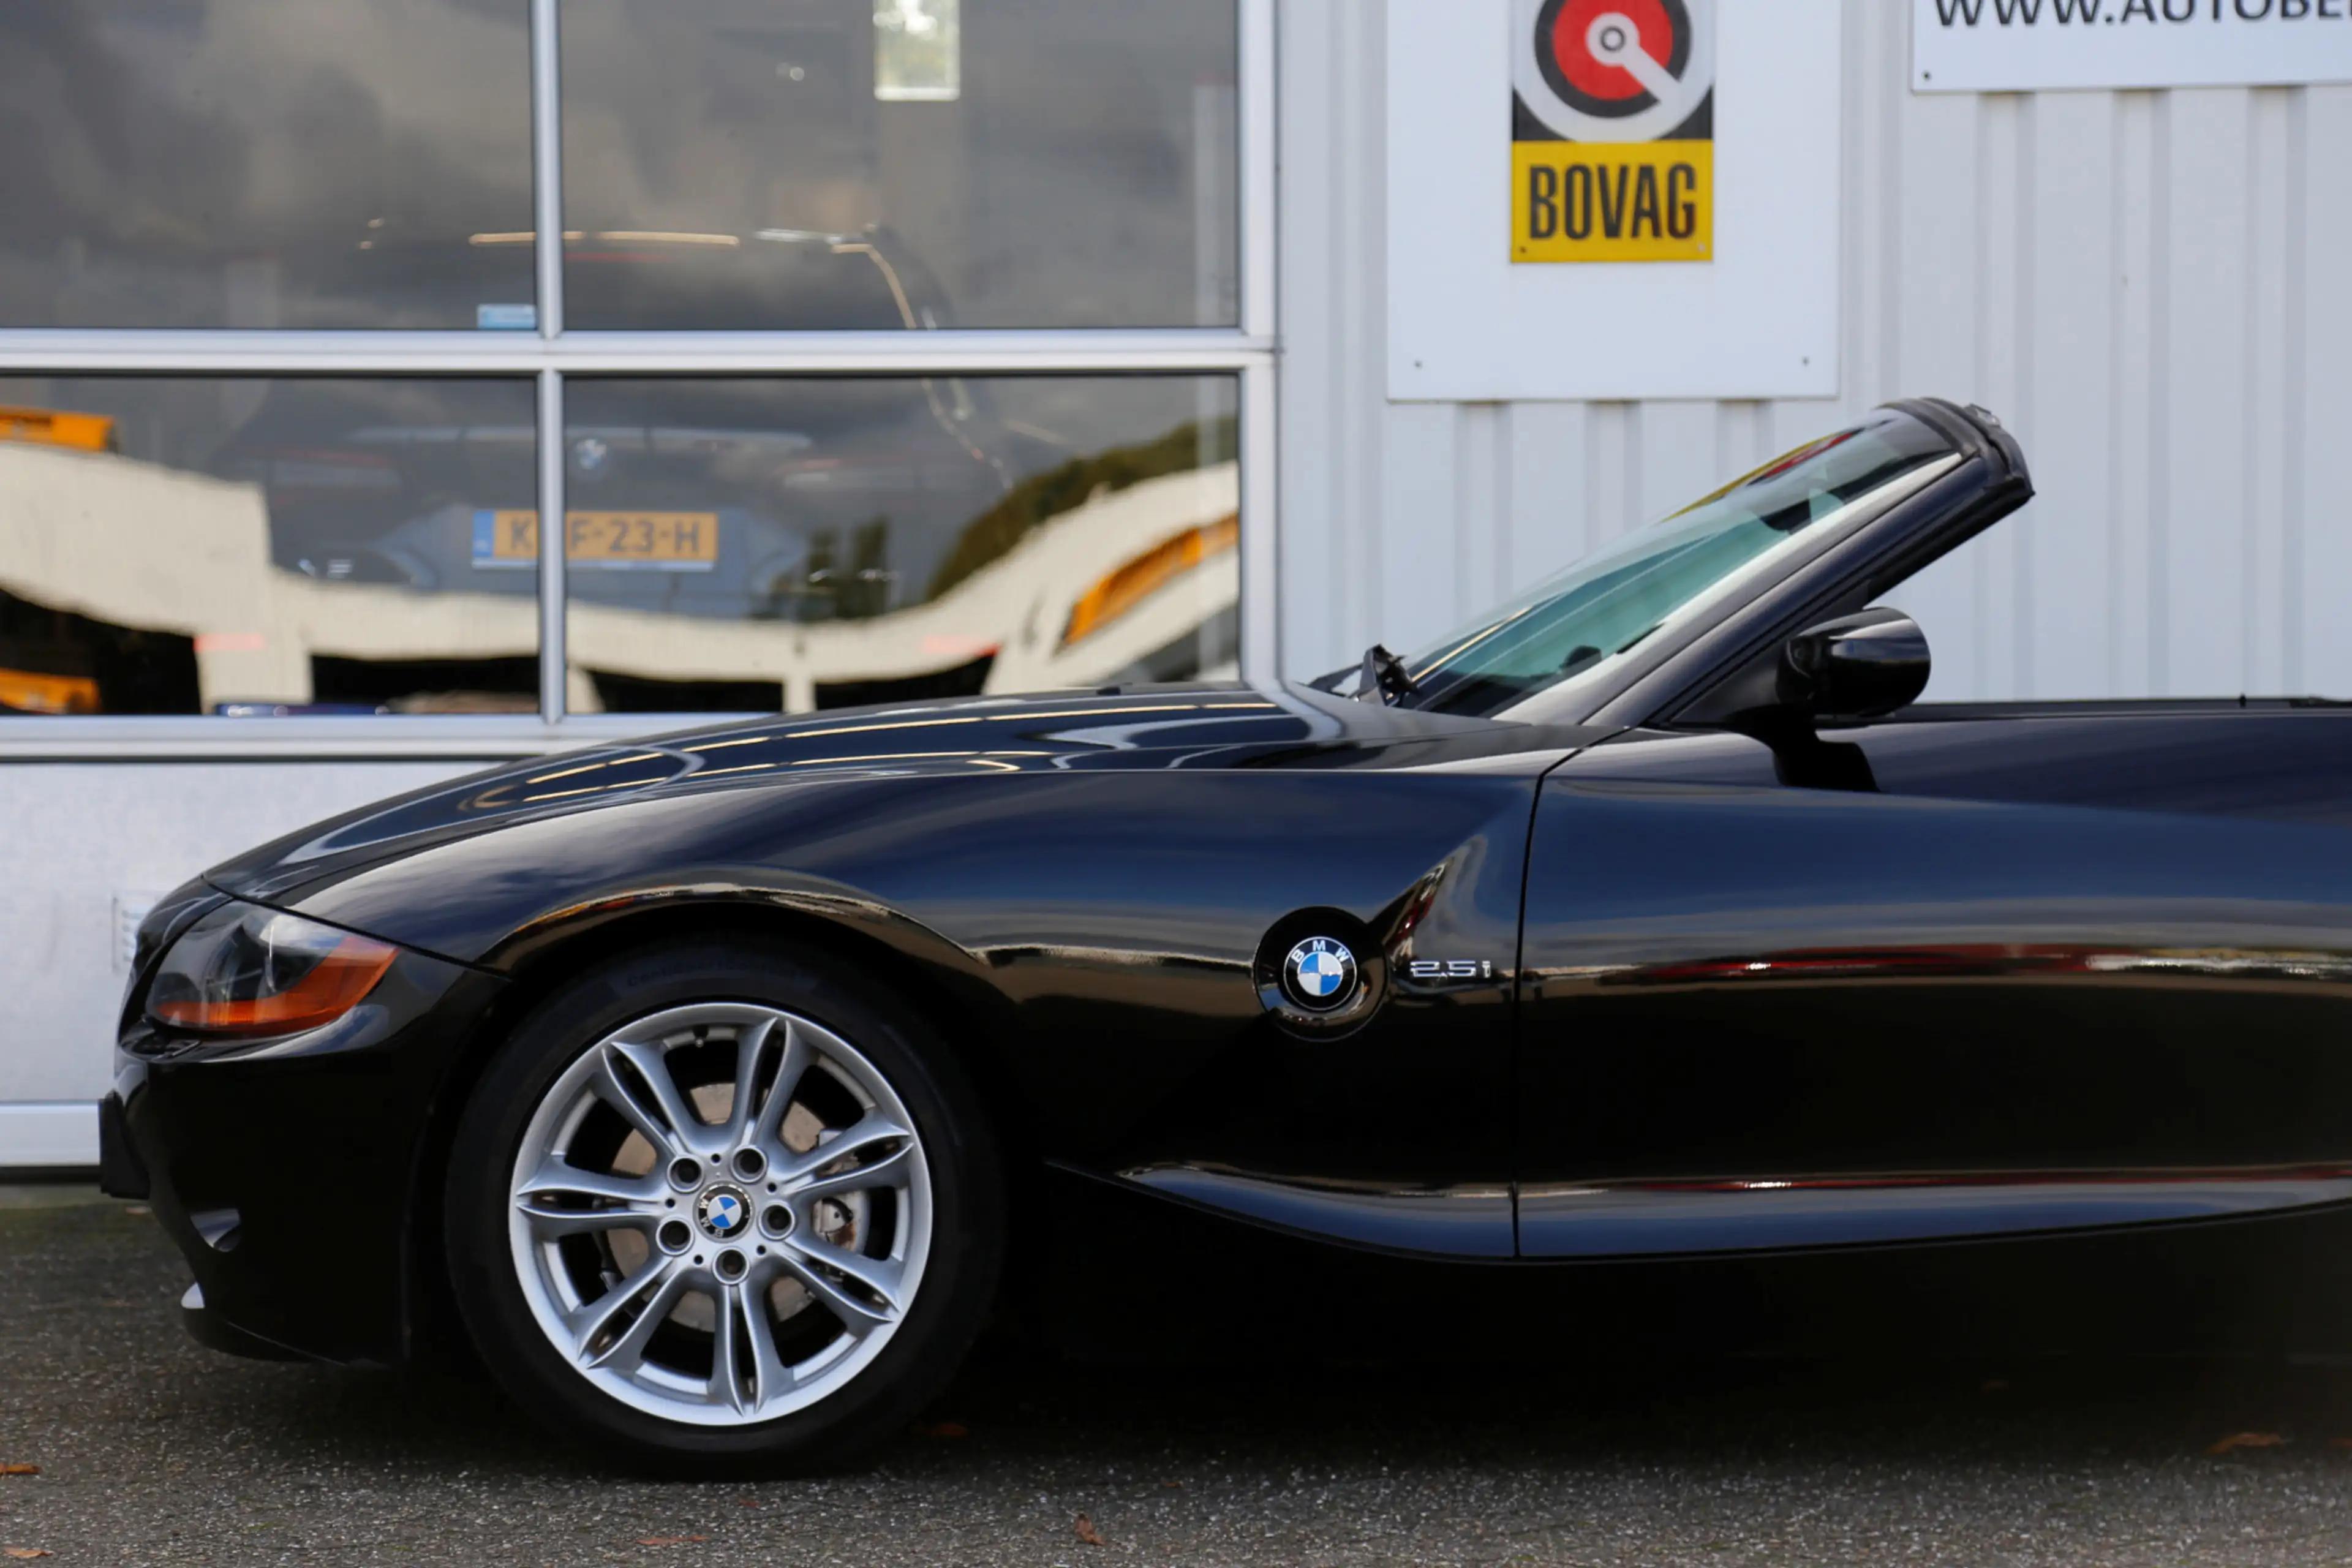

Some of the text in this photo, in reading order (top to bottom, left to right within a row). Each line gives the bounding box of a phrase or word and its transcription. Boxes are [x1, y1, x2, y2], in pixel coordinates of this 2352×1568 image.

[1935, 0, 2352, 26] WWW.AUTOBE
[1529, 162, 1697, 239] BOVAG
[510, 517, 699, 554] KF-23-H
[1291, 940, 1350, 963] BMW
[698, 1198, 724, 1238] BMW
